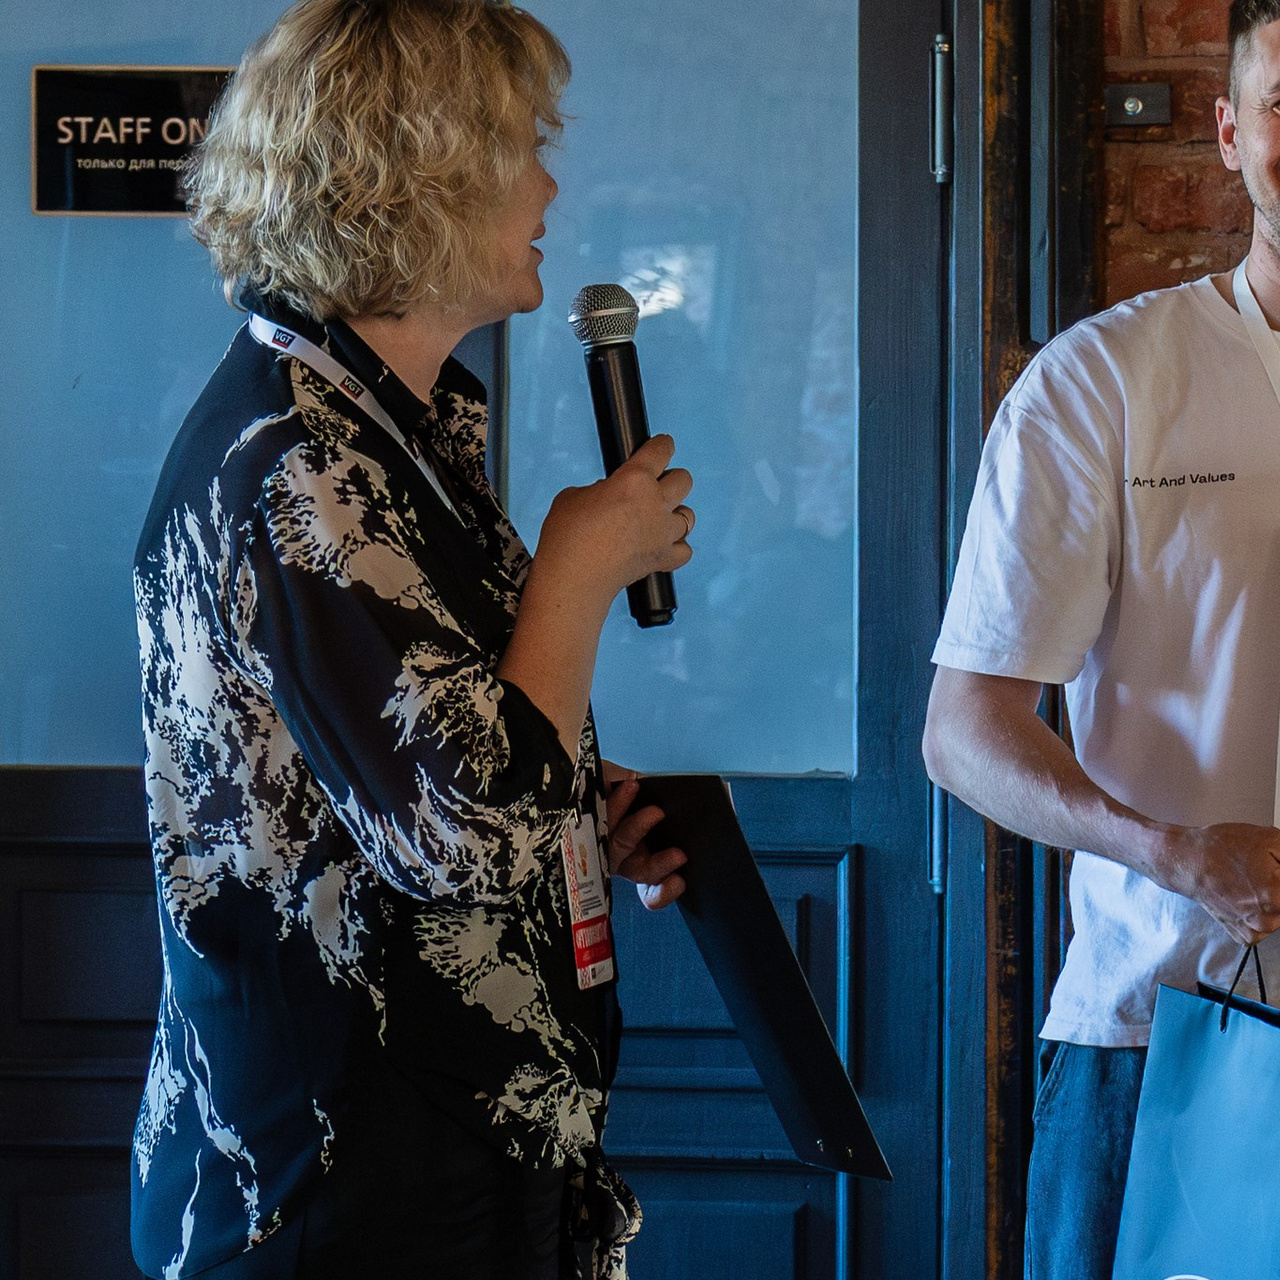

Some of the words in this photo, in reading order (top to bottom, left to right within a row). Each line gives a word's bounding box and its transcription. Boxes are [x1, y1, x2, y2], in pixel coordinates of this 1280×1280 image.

[56, 116, 152, 144] STAFF
[76, 158, 127, 169] только
[128, 158, 157, 171] для
[275, 330, 294, 344] VGT
[344, 377, 362, 395] VGT
[1132, 477, 1156, 488] Art
[1159, 474, 1186, 488] And
[1189, 472, 1236, 484] Values
